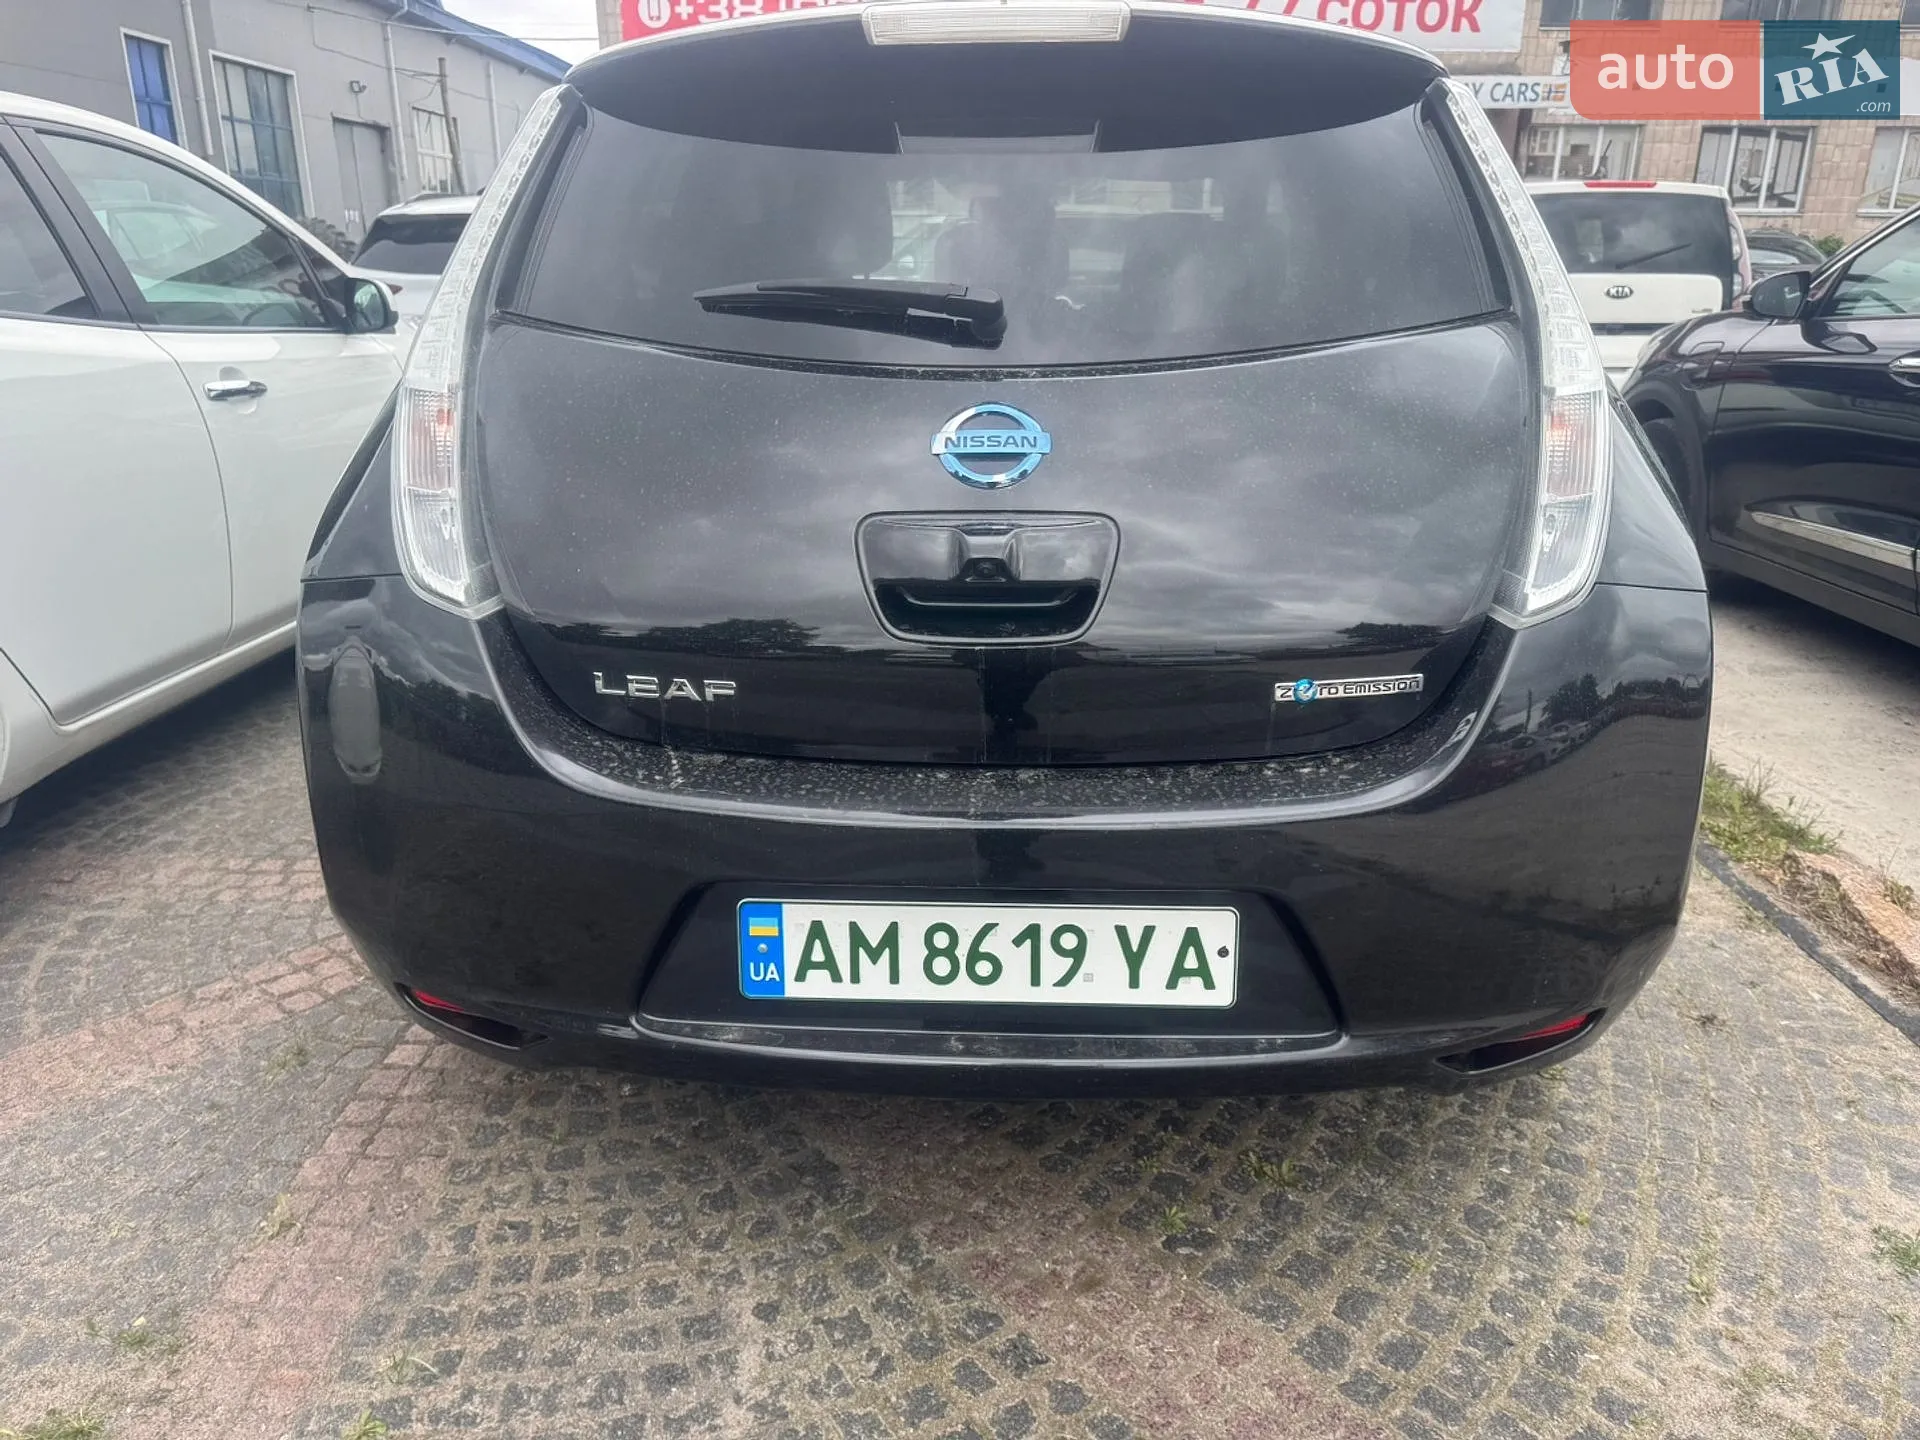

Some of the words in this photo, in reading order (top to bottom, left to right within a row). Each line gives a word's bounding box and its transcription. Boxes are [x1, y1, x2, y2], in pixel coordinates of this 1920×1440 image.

[1490, 82, 1541, 103] CARS
[1608, 286, 1632, 298] KIA
[944, 436, 1037, 448] NISSAN
[593, 672, 736, 701] LEAF
[794, 920, 900, 984] AM
[923, 921, 1088, 987] 8619
[1114, 924, 1216, 990] YA
[749, 963, 780, 982] UA
